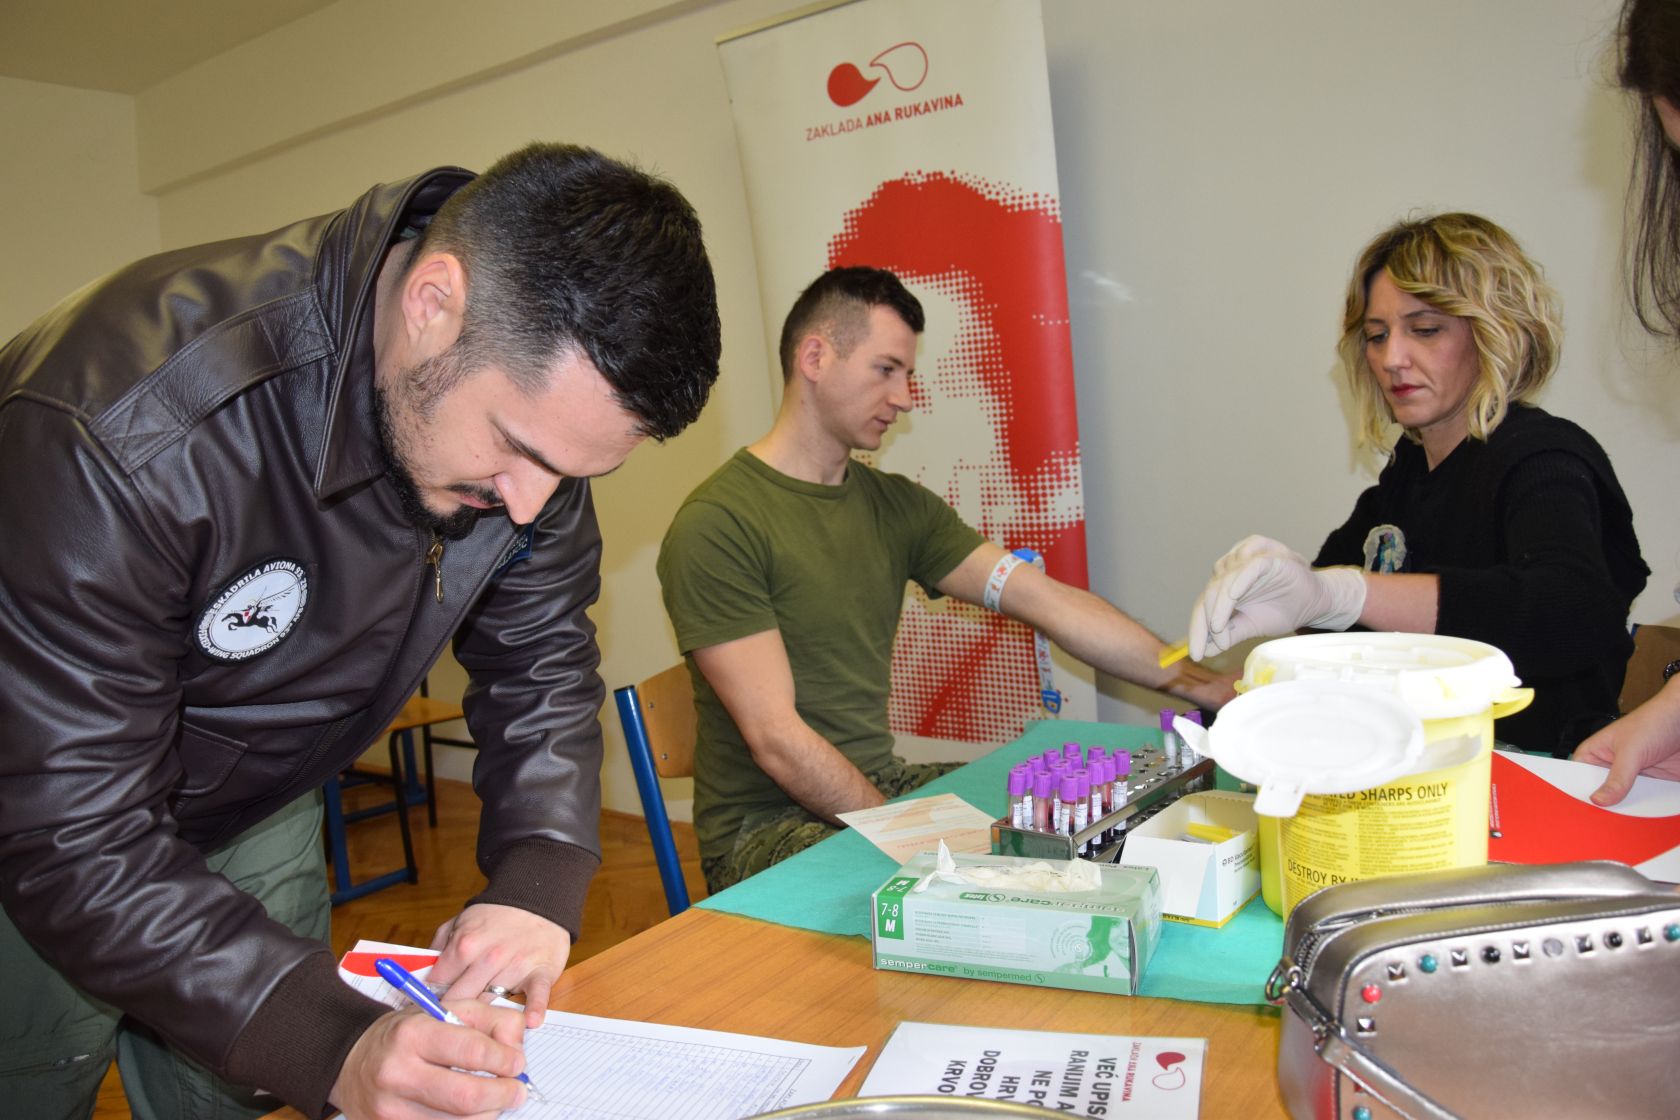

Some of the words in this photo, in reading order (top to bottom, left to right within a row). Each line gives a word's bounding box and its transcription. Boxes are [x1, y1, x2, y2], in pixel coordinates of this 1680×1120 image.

[806, 117, 863, 141] ZAKLADA
[866, 110, 891, 128] ANA
[895, 93, 964, 120] RUKAVINA
[208, 569, 261, 614] ESKADRILA
[263, 561, 296, 574] AVIONA
[229, 637, 280, 660] SQUADRON
[1360, 786, 1412, 801] SHARPS
[1417, 782, 1448, 799] ONLY
[1288, 859, 1327, 885] DESTROY
[881, 902, 899, 918] 7-8
[885, 919, 896, 932] M
[963, 966, 975, 977] by
[977, 968, 1032, 983] sempermed
[937, 1059, 968, 1094] KRVO
[1031, 1070, 1053, 1087] NE
[1059, 1050, 1089, 1098] RANIJIM
[1097, 1057, 1118, 1079] VEĆ
